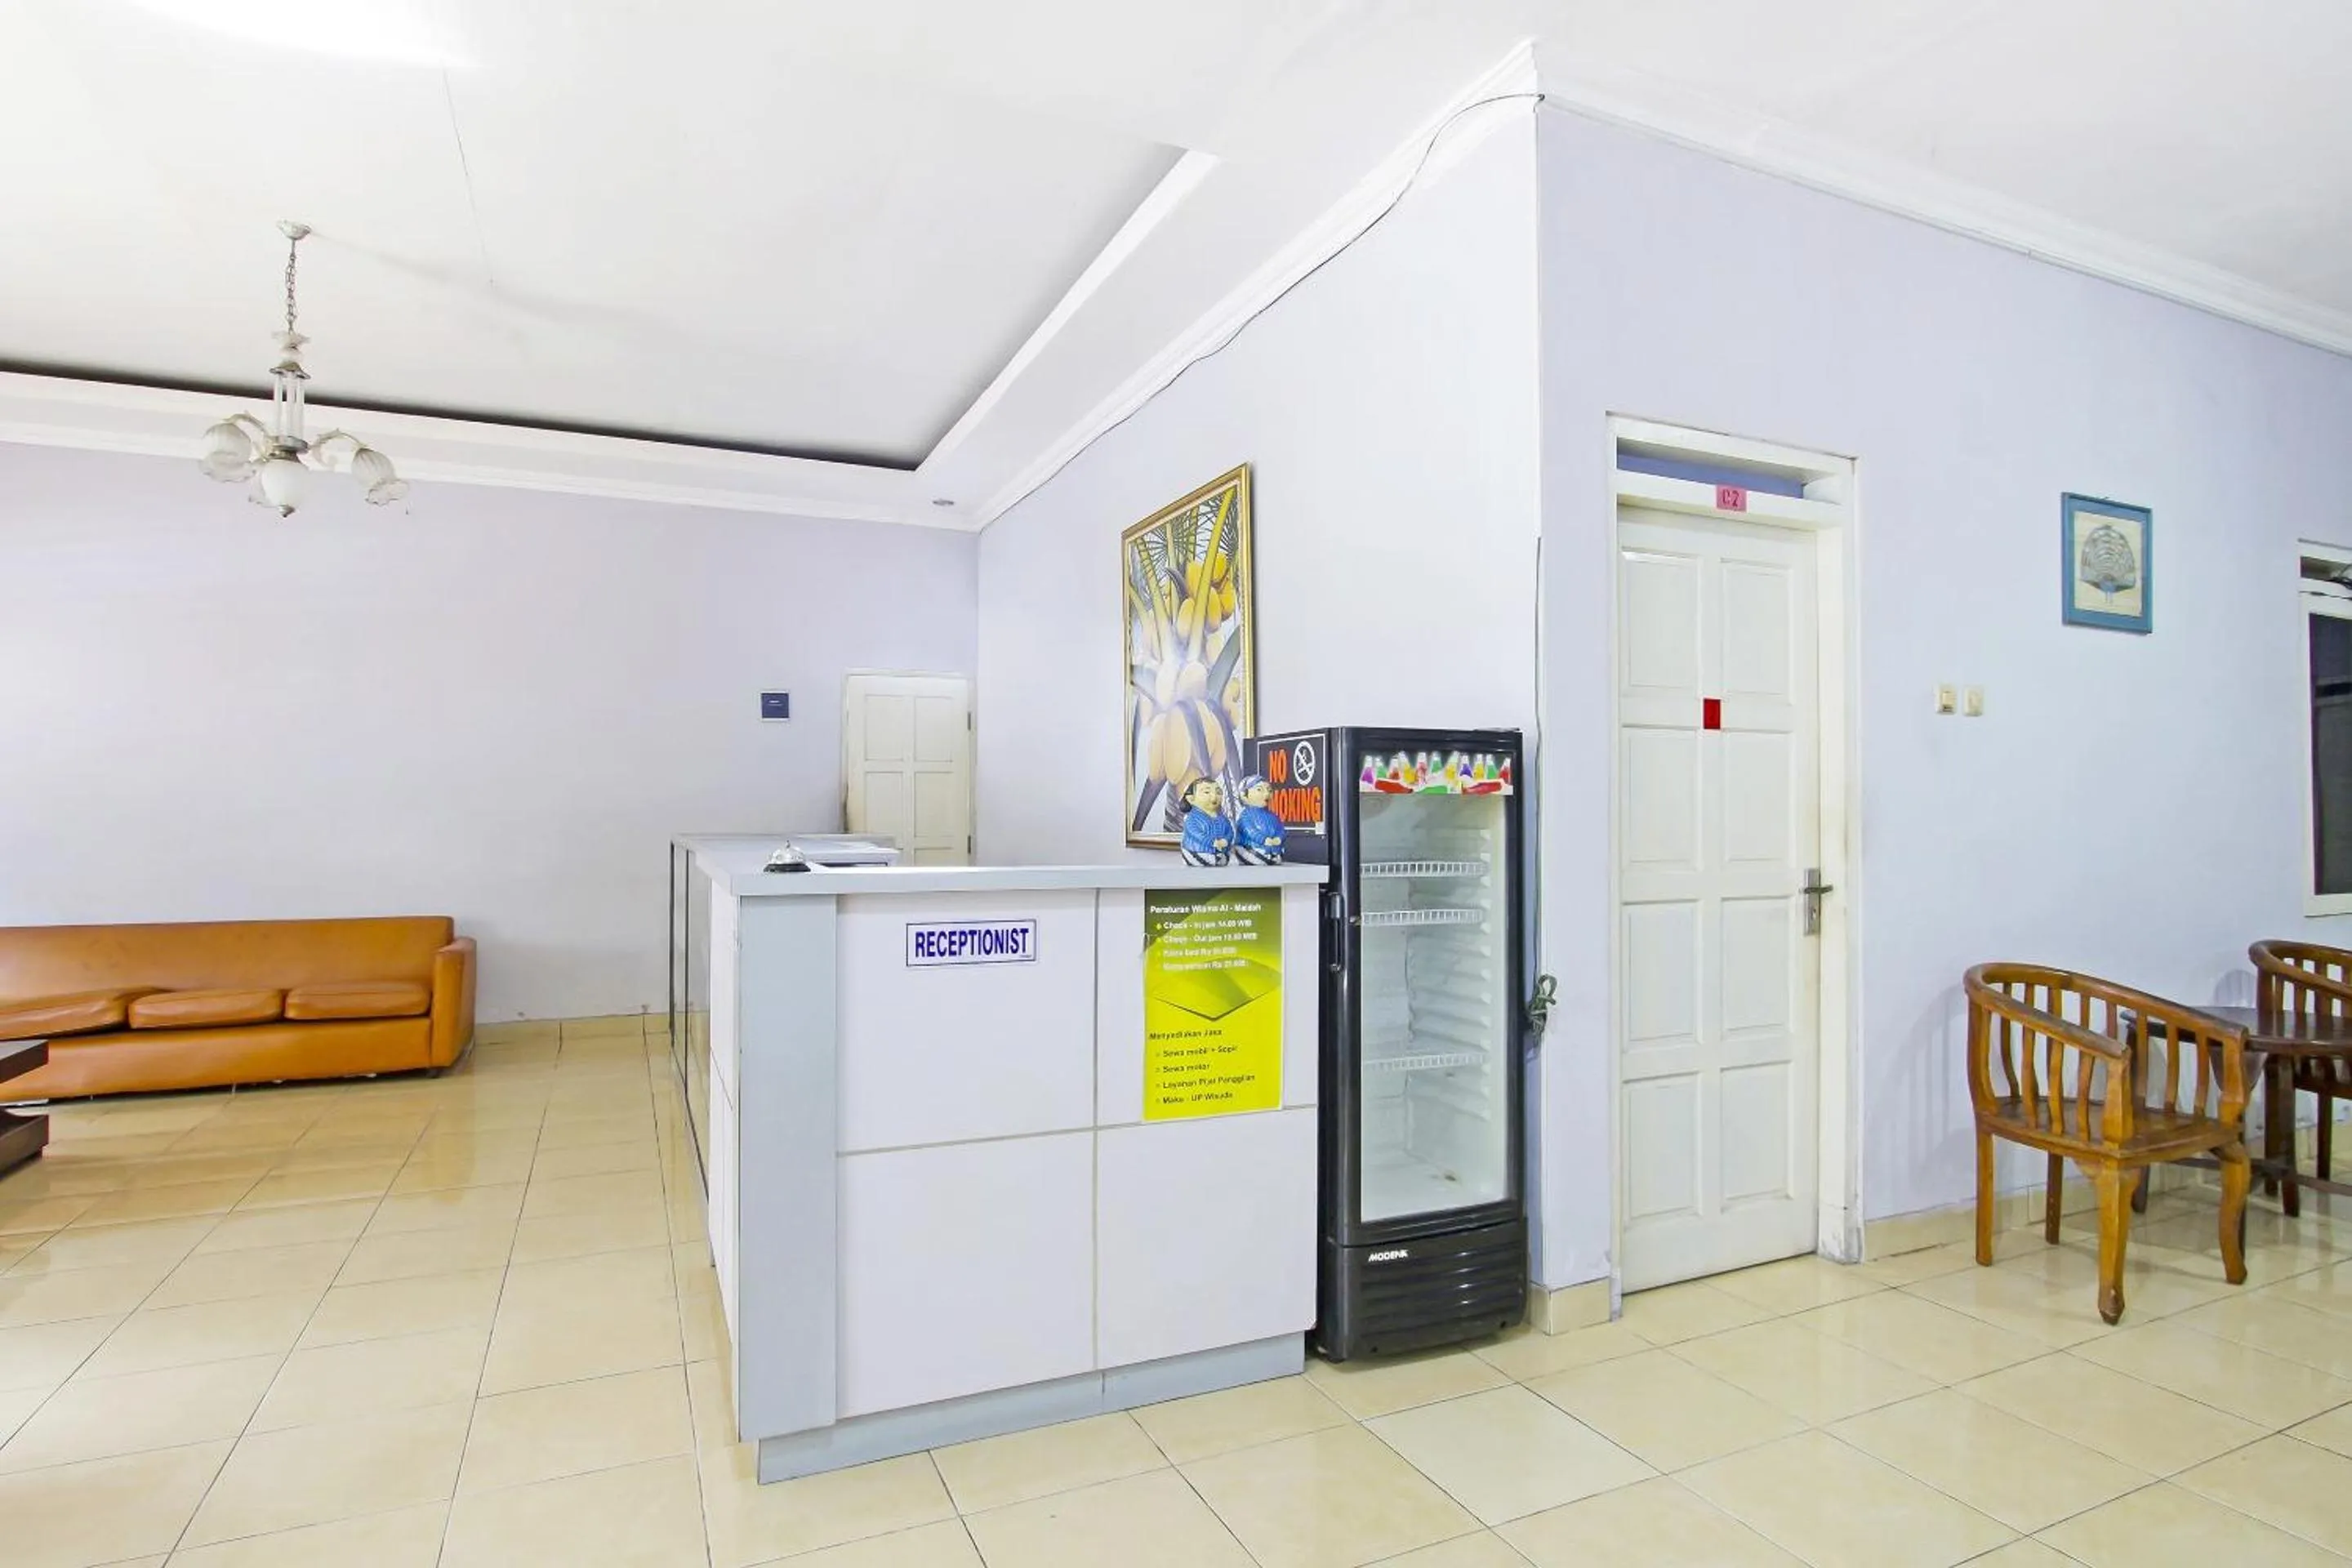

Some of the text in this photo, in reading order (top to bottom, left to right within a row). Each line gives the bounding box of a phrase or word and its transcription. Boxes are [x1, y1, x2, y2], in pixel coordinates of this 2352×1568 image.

[1269, 749, 1287, 783] NO
[1268, 786, 1321, 822] MOKING
[915, 928, 1029, 958] RECEPTIONIST
[1368, 1250, 1409, 1263] MODENA
